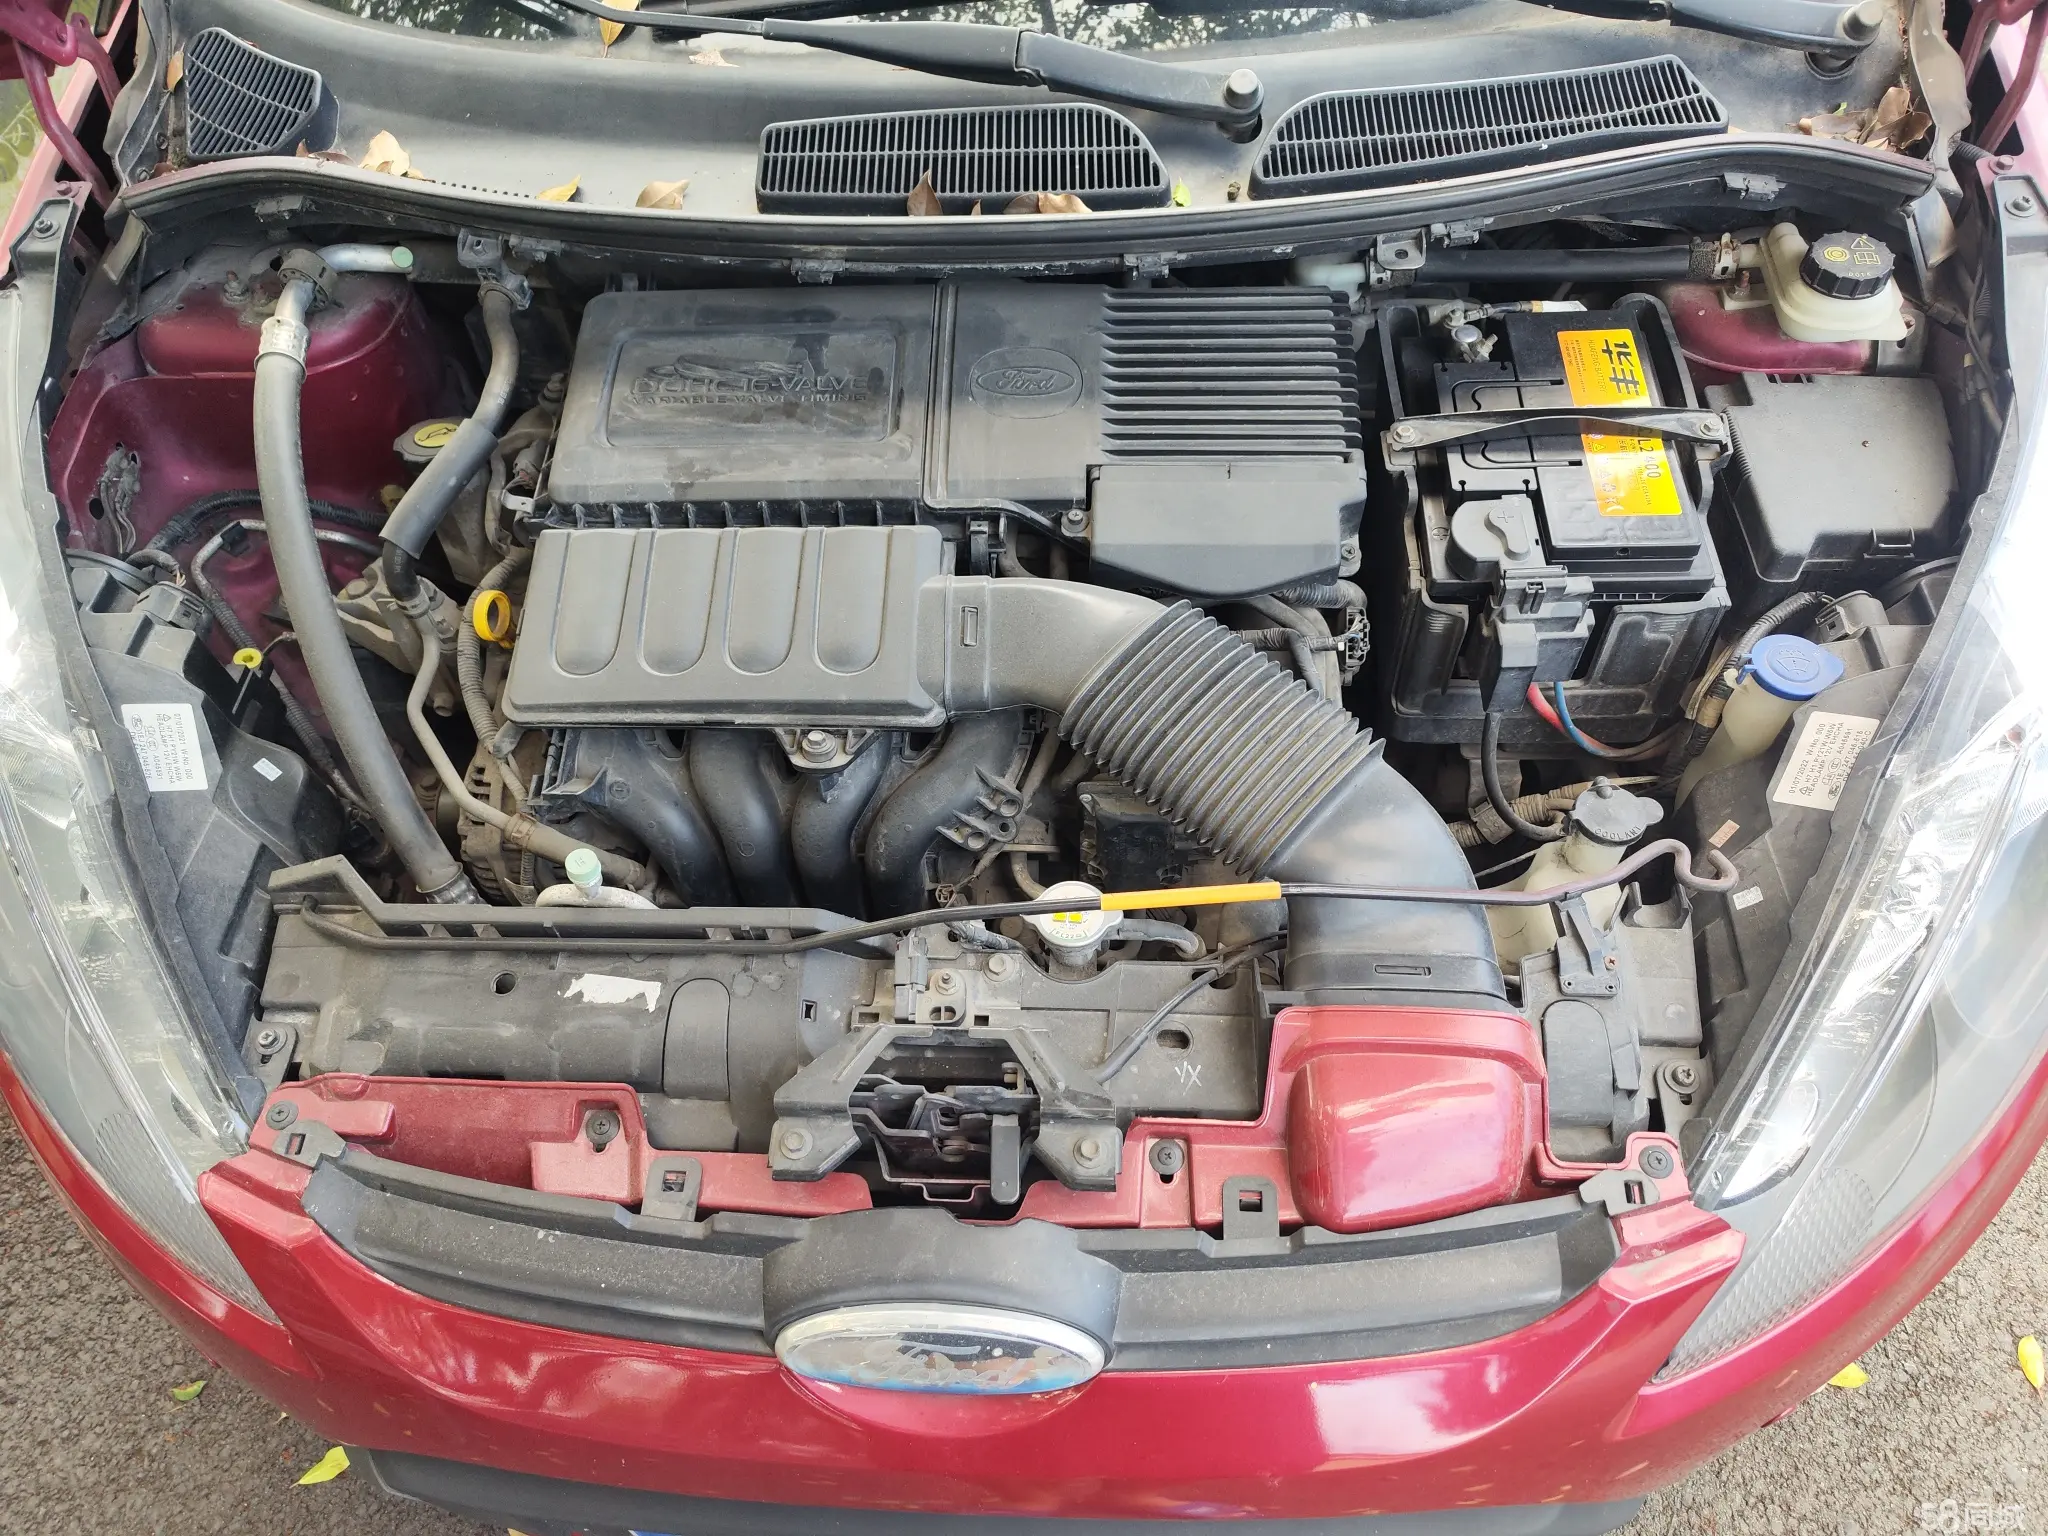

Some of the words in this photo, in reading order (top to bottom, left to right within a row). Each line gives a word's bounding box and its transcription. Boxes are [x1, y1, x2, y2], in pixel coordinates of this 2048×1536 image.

[996, 369, 1057, 390] Ford
[1595, 367, 1607, 392] BATTERY
[156, 713, 168, 748] HEADLAMP
[1806, 759, 1826, 797] HEADLAMP
[1824, 745, 1833, 757] 12V
[1594, 825, 1642, 841] COOLANT
